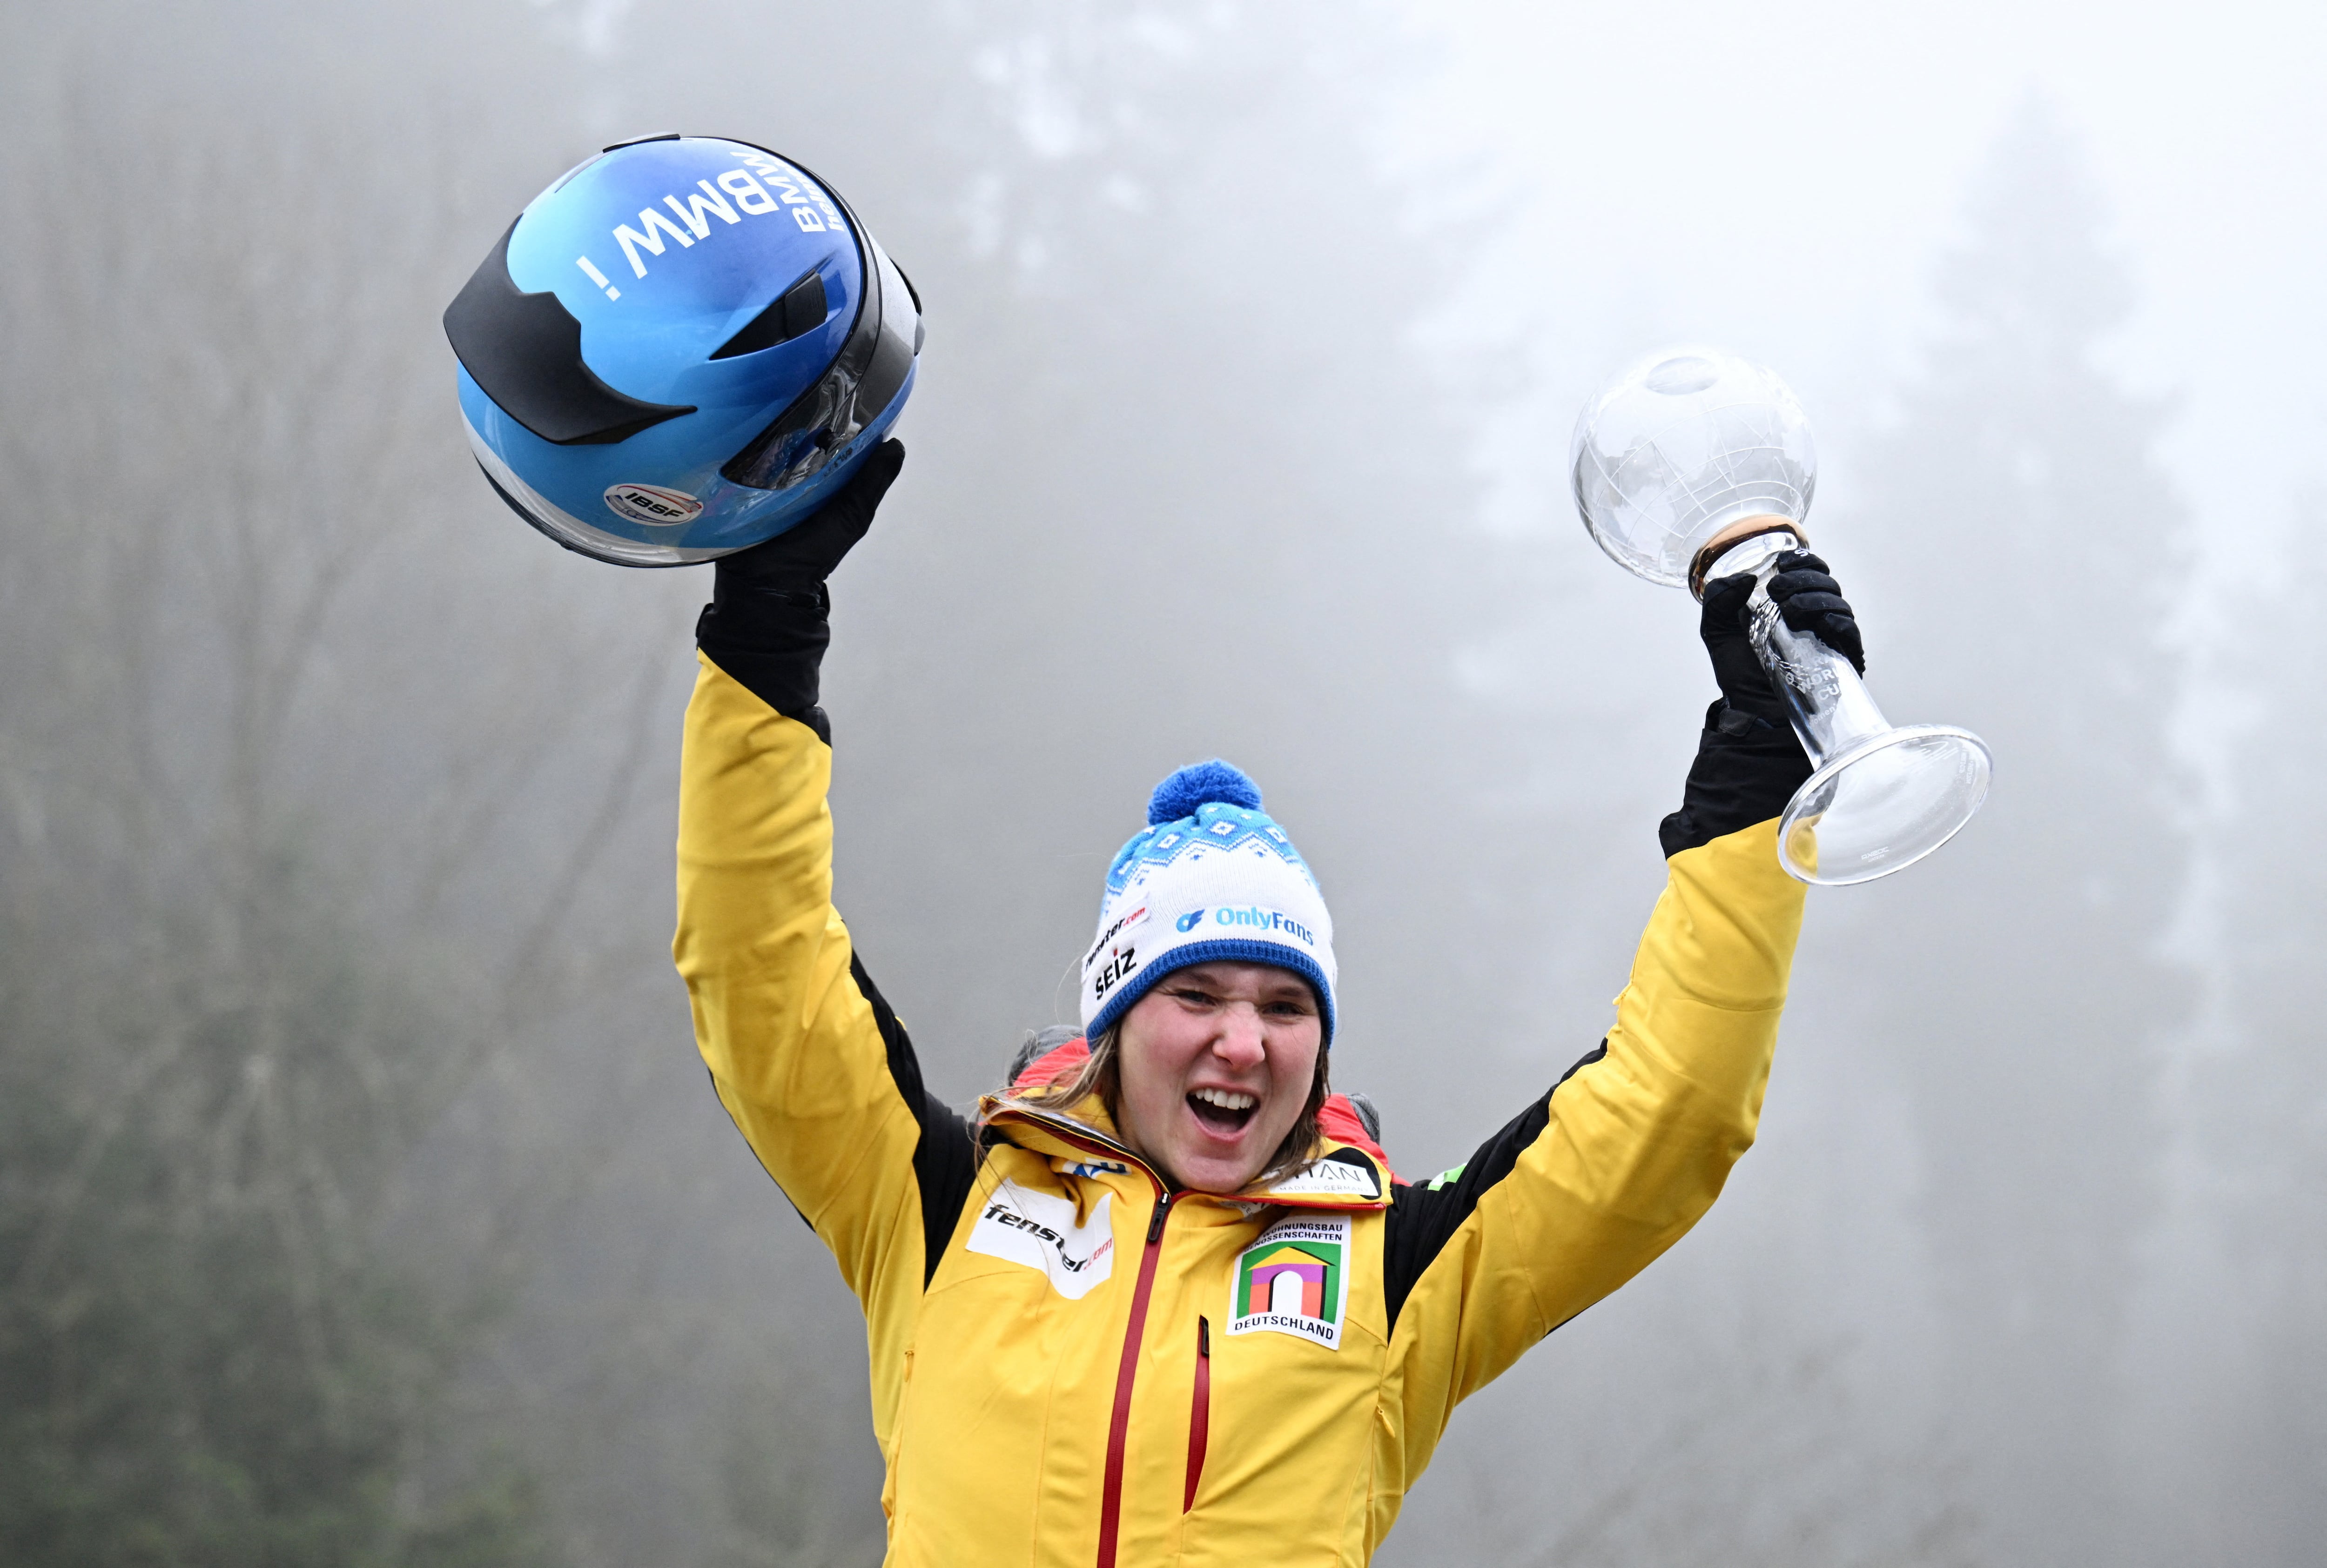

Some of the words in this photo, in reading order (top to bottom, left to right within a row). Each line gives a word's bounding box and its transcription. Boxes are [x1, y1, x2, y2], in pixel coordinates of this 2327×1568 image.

[730, 152, 826, 232] BMW
[612, 169, 779, 279] BMW
[625, 492, 684, 517] IBSF
[1216, 906, 1314, 946] OnlyFans
[984, 1204, 1113, 1273] fenster.com
[1263, 1222, 1343, 1238] WOHNUNGSBAU
[1235, 1315, 1334, 1340] DEUTSCHLAND
